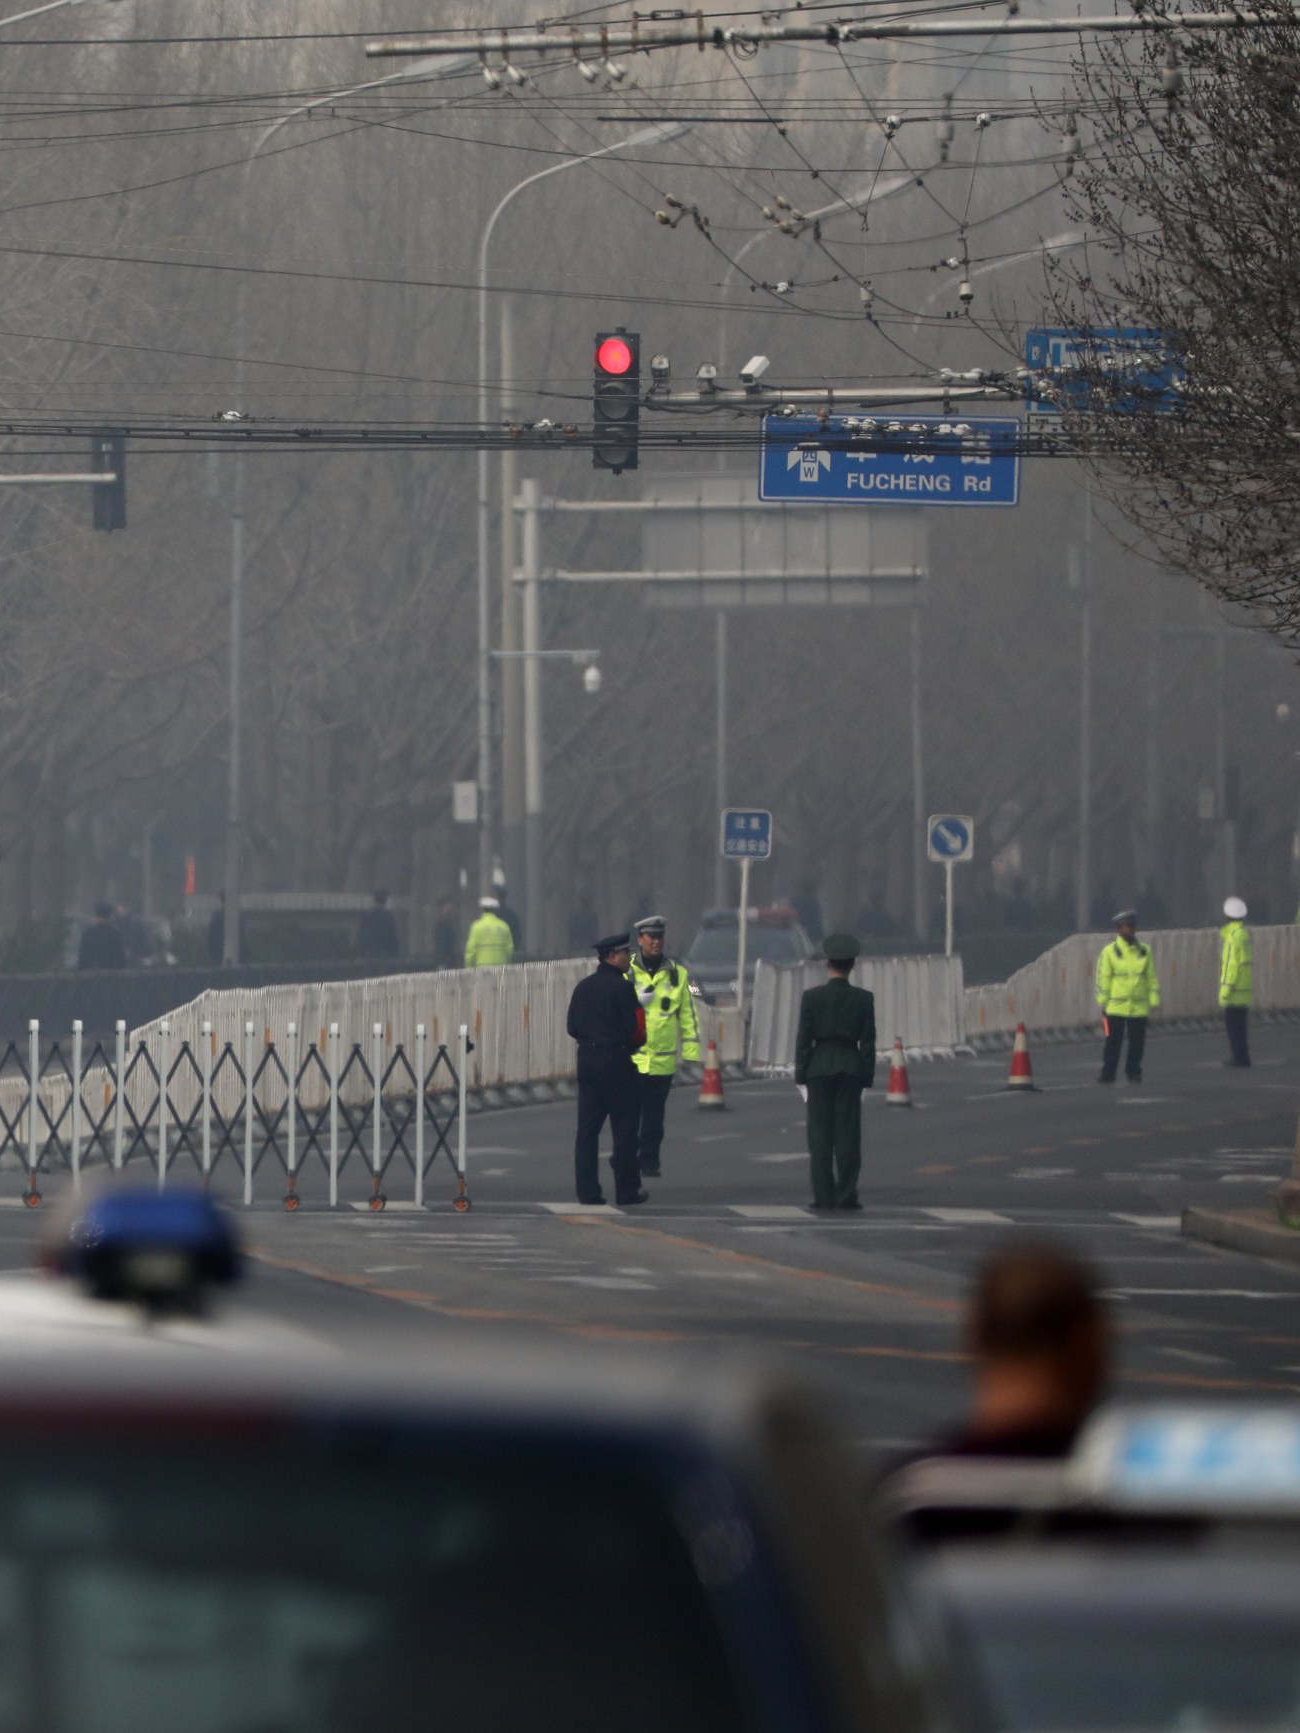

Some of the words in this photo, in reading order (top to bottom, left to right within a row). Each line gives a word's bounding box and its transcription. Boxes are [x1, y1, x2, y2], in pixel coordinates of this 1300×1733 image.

[803, 466, 815, 479] W
[847, 472, 951, 492] FUCHENG
[963, 475, 992, 492] Rd
